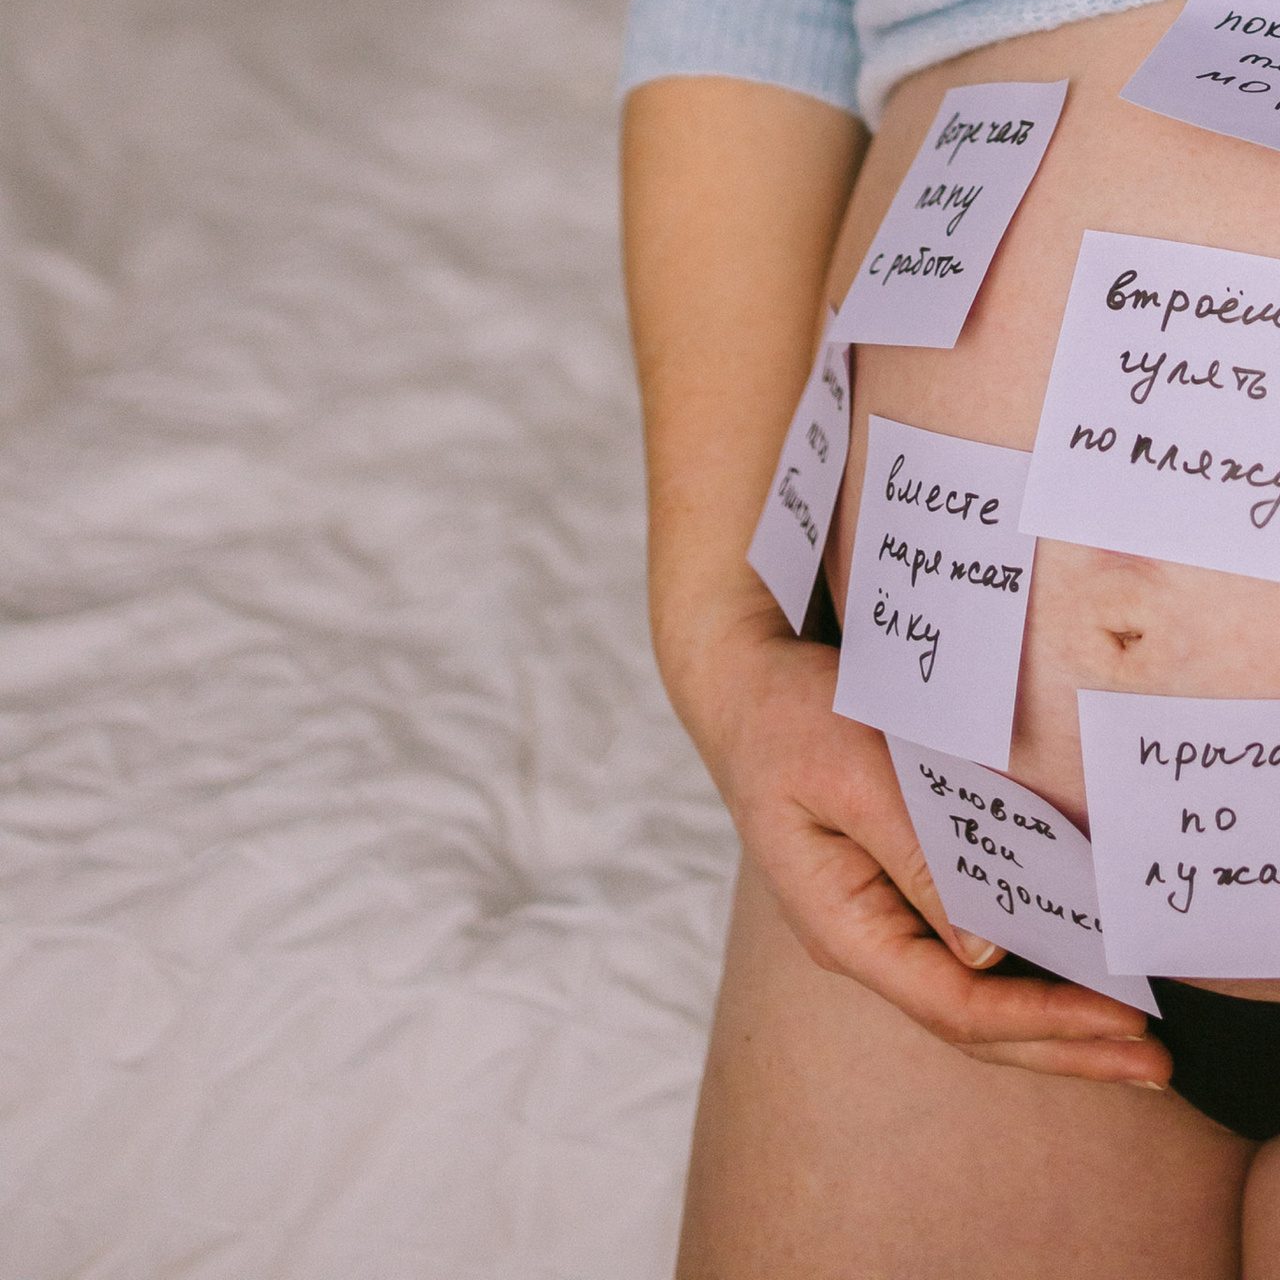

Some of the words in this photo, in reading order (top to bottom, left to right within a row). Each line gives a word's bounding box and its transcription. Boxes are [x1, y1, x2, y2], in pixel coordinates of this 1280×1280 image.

[914, 183, 984, 237] папу
[868, 252, 885, 276] с
[879, 246, 965, 287] работы
[1119, 350, 1268, 405] гулять
[1069, 423, 1117, 453] по
[885, 453, 1000, 526] вместе
[878, 532, 1024, 595] наряжать
[872, 587, 941, 684] ёлку
[919, 761, 1059, 842] целовать
[1181, 806, 1237, 834] по
[948, 812, 1026, 871] твои
